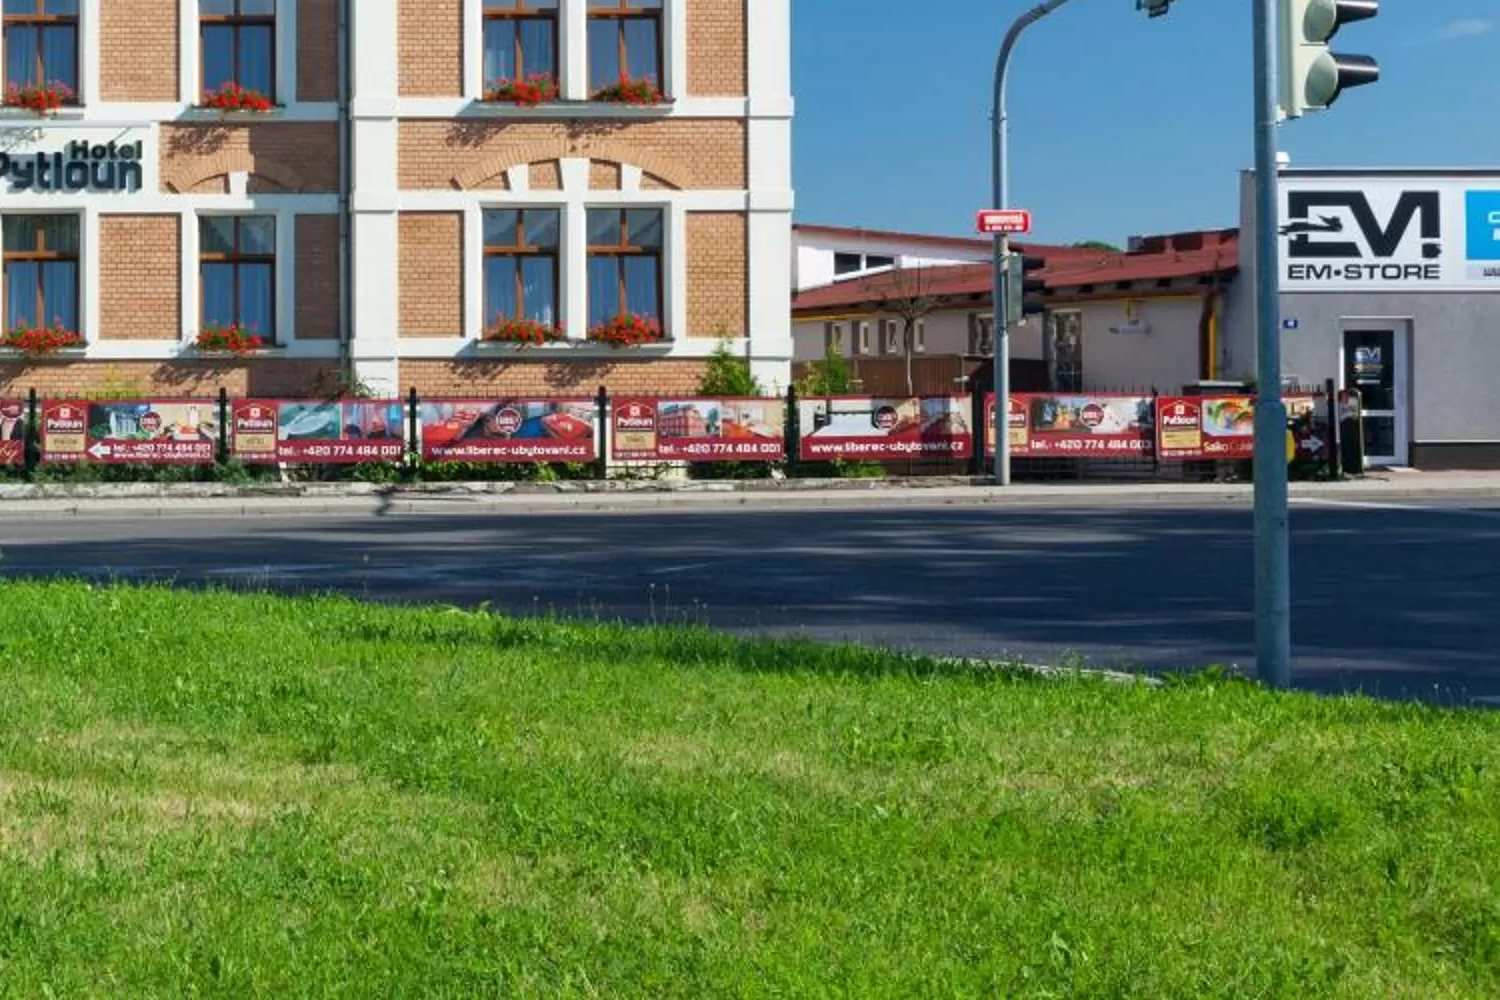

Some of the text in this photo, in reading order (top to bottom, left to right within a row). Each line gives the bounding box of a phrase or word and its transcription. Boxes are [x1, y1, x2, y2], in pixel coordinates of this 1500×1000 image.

[71, 139, 143, 159] Hotel
[303, 446, 331, 457] +420
[333, 446, 353, 456] 774
[356, 446, 378, 456] 484
[682, 443, 710, 454] +420
[713, 443, 733, 454] 774
